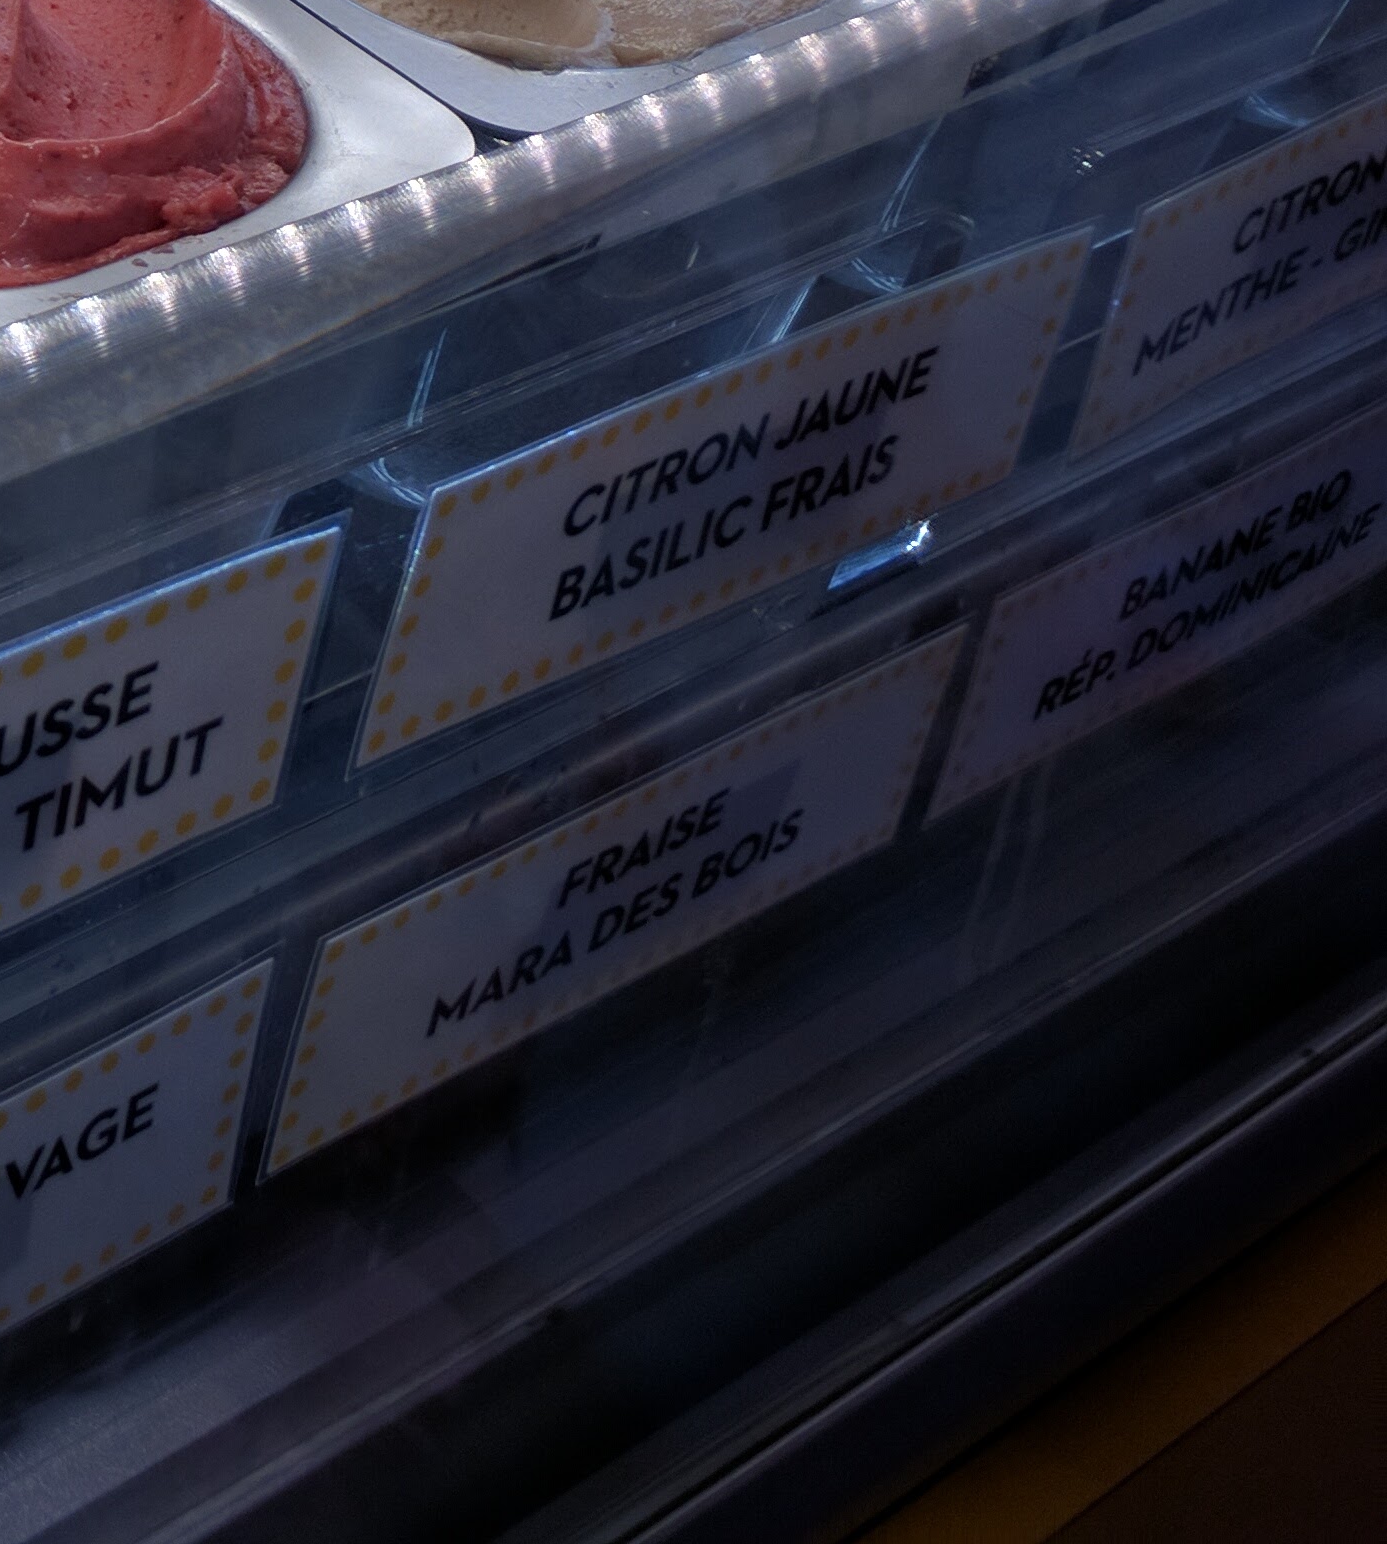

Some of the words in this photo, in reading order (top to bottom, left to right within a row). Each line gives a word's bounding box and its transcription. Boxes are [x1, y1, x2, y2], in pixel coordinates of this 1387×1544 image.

[1233, 147, 1387, 254] CITRON
[1132, 247, 1310, 376] MENTHE
[564, 416, 770, 538] CITRON
[773, 348, 939, 450] JAUNE
[550, 496, 753, 622] BASILIC
[760, 435, 900, 533] FRAIS
[1121, 506, 1283, 620] BANANE
[1287, 469, 1352, 532] BIO
[1034, 648, 1116, 721] RÉP.
[1127, 503, 1381, 671] DOMINICAINE
[15, 719, 223, 852] TIMUT
[559, 789, 729, 908] FRAISE
[426, 931, 574, 1038] MARA
[588, 872, 679, 952] DES
[693, 809, 804, 897] BOIS
